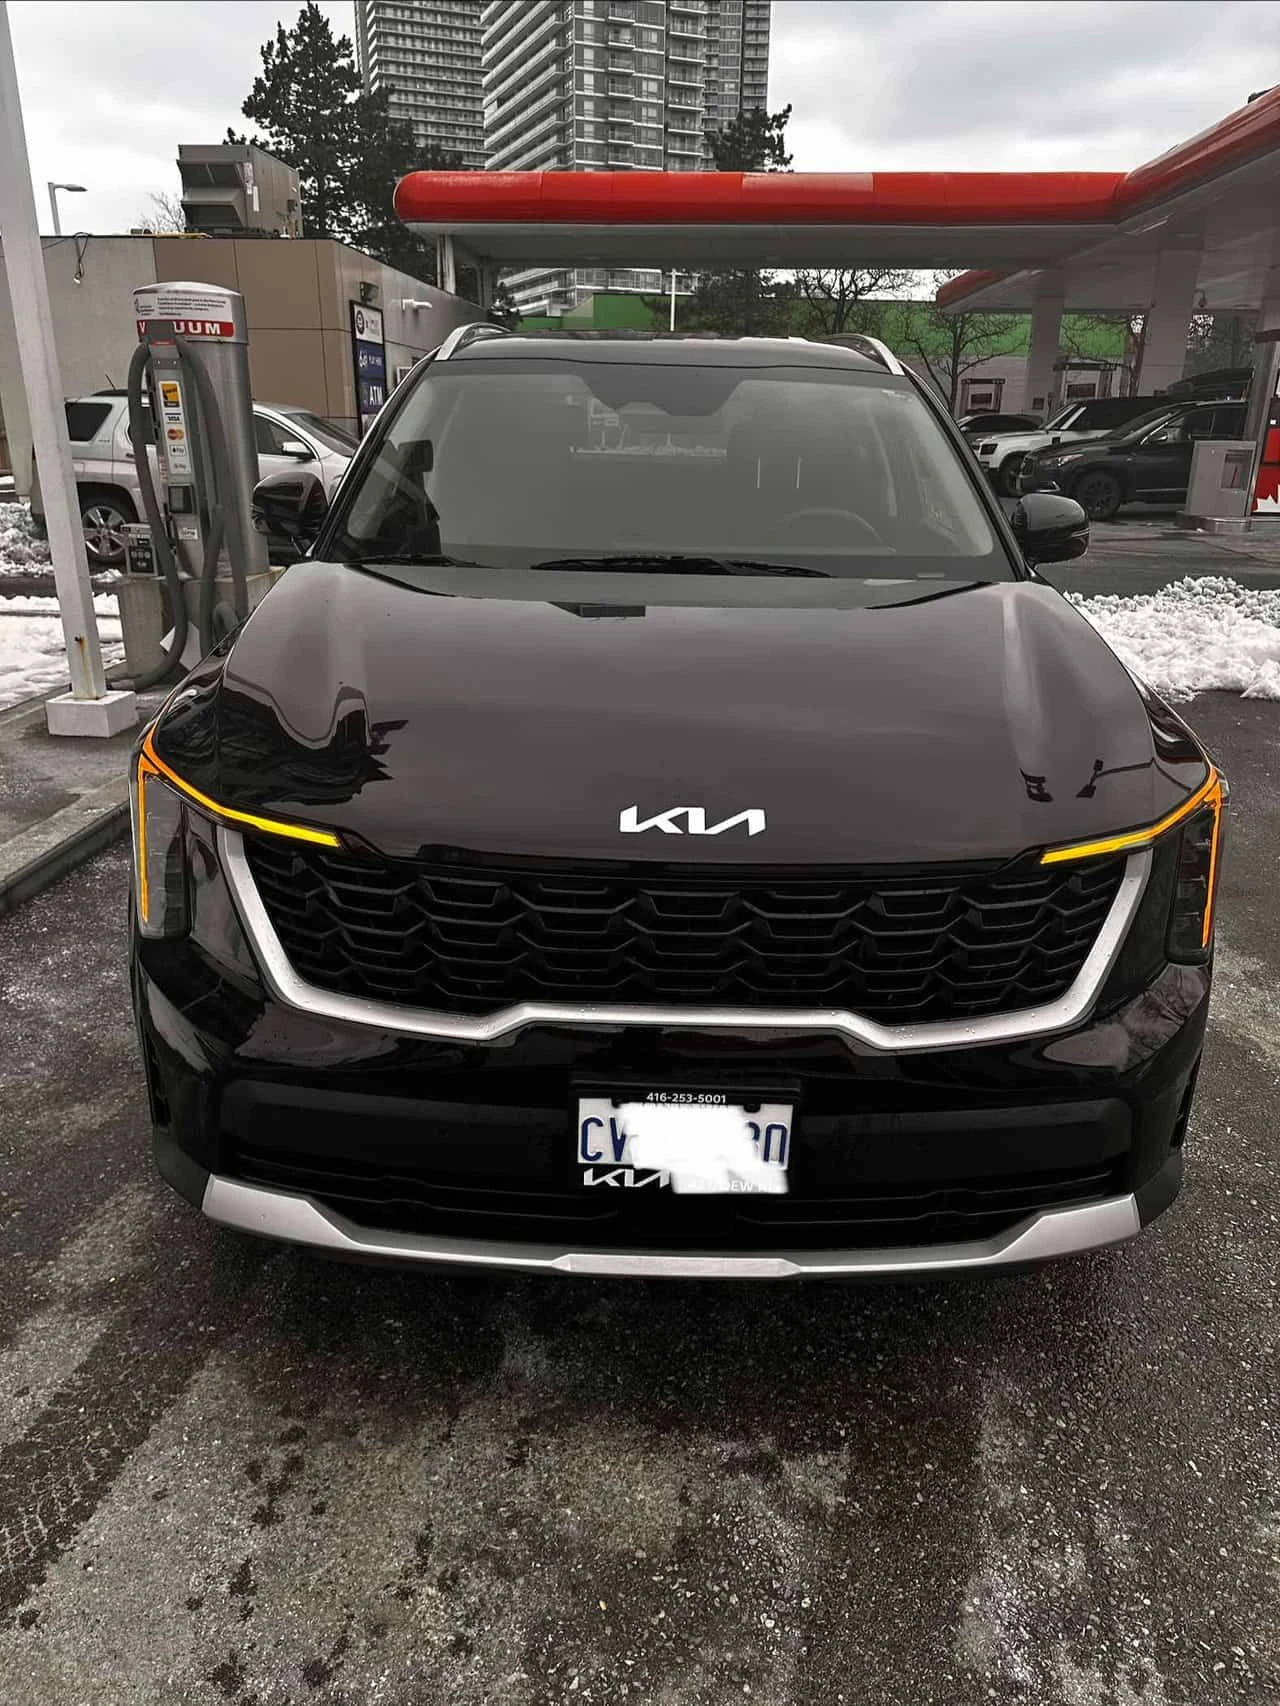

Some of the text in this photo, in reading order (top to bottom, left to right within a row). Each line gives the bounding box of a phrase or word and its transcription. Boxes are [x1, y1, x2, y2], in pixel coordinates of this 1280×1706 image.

[139, 320, 221, 335] VUUM
[369, 385, 384, 406] ATM
[619, 805, 766, 836] KIA
[646, 1092, 727, 1104] 416-253-5001
